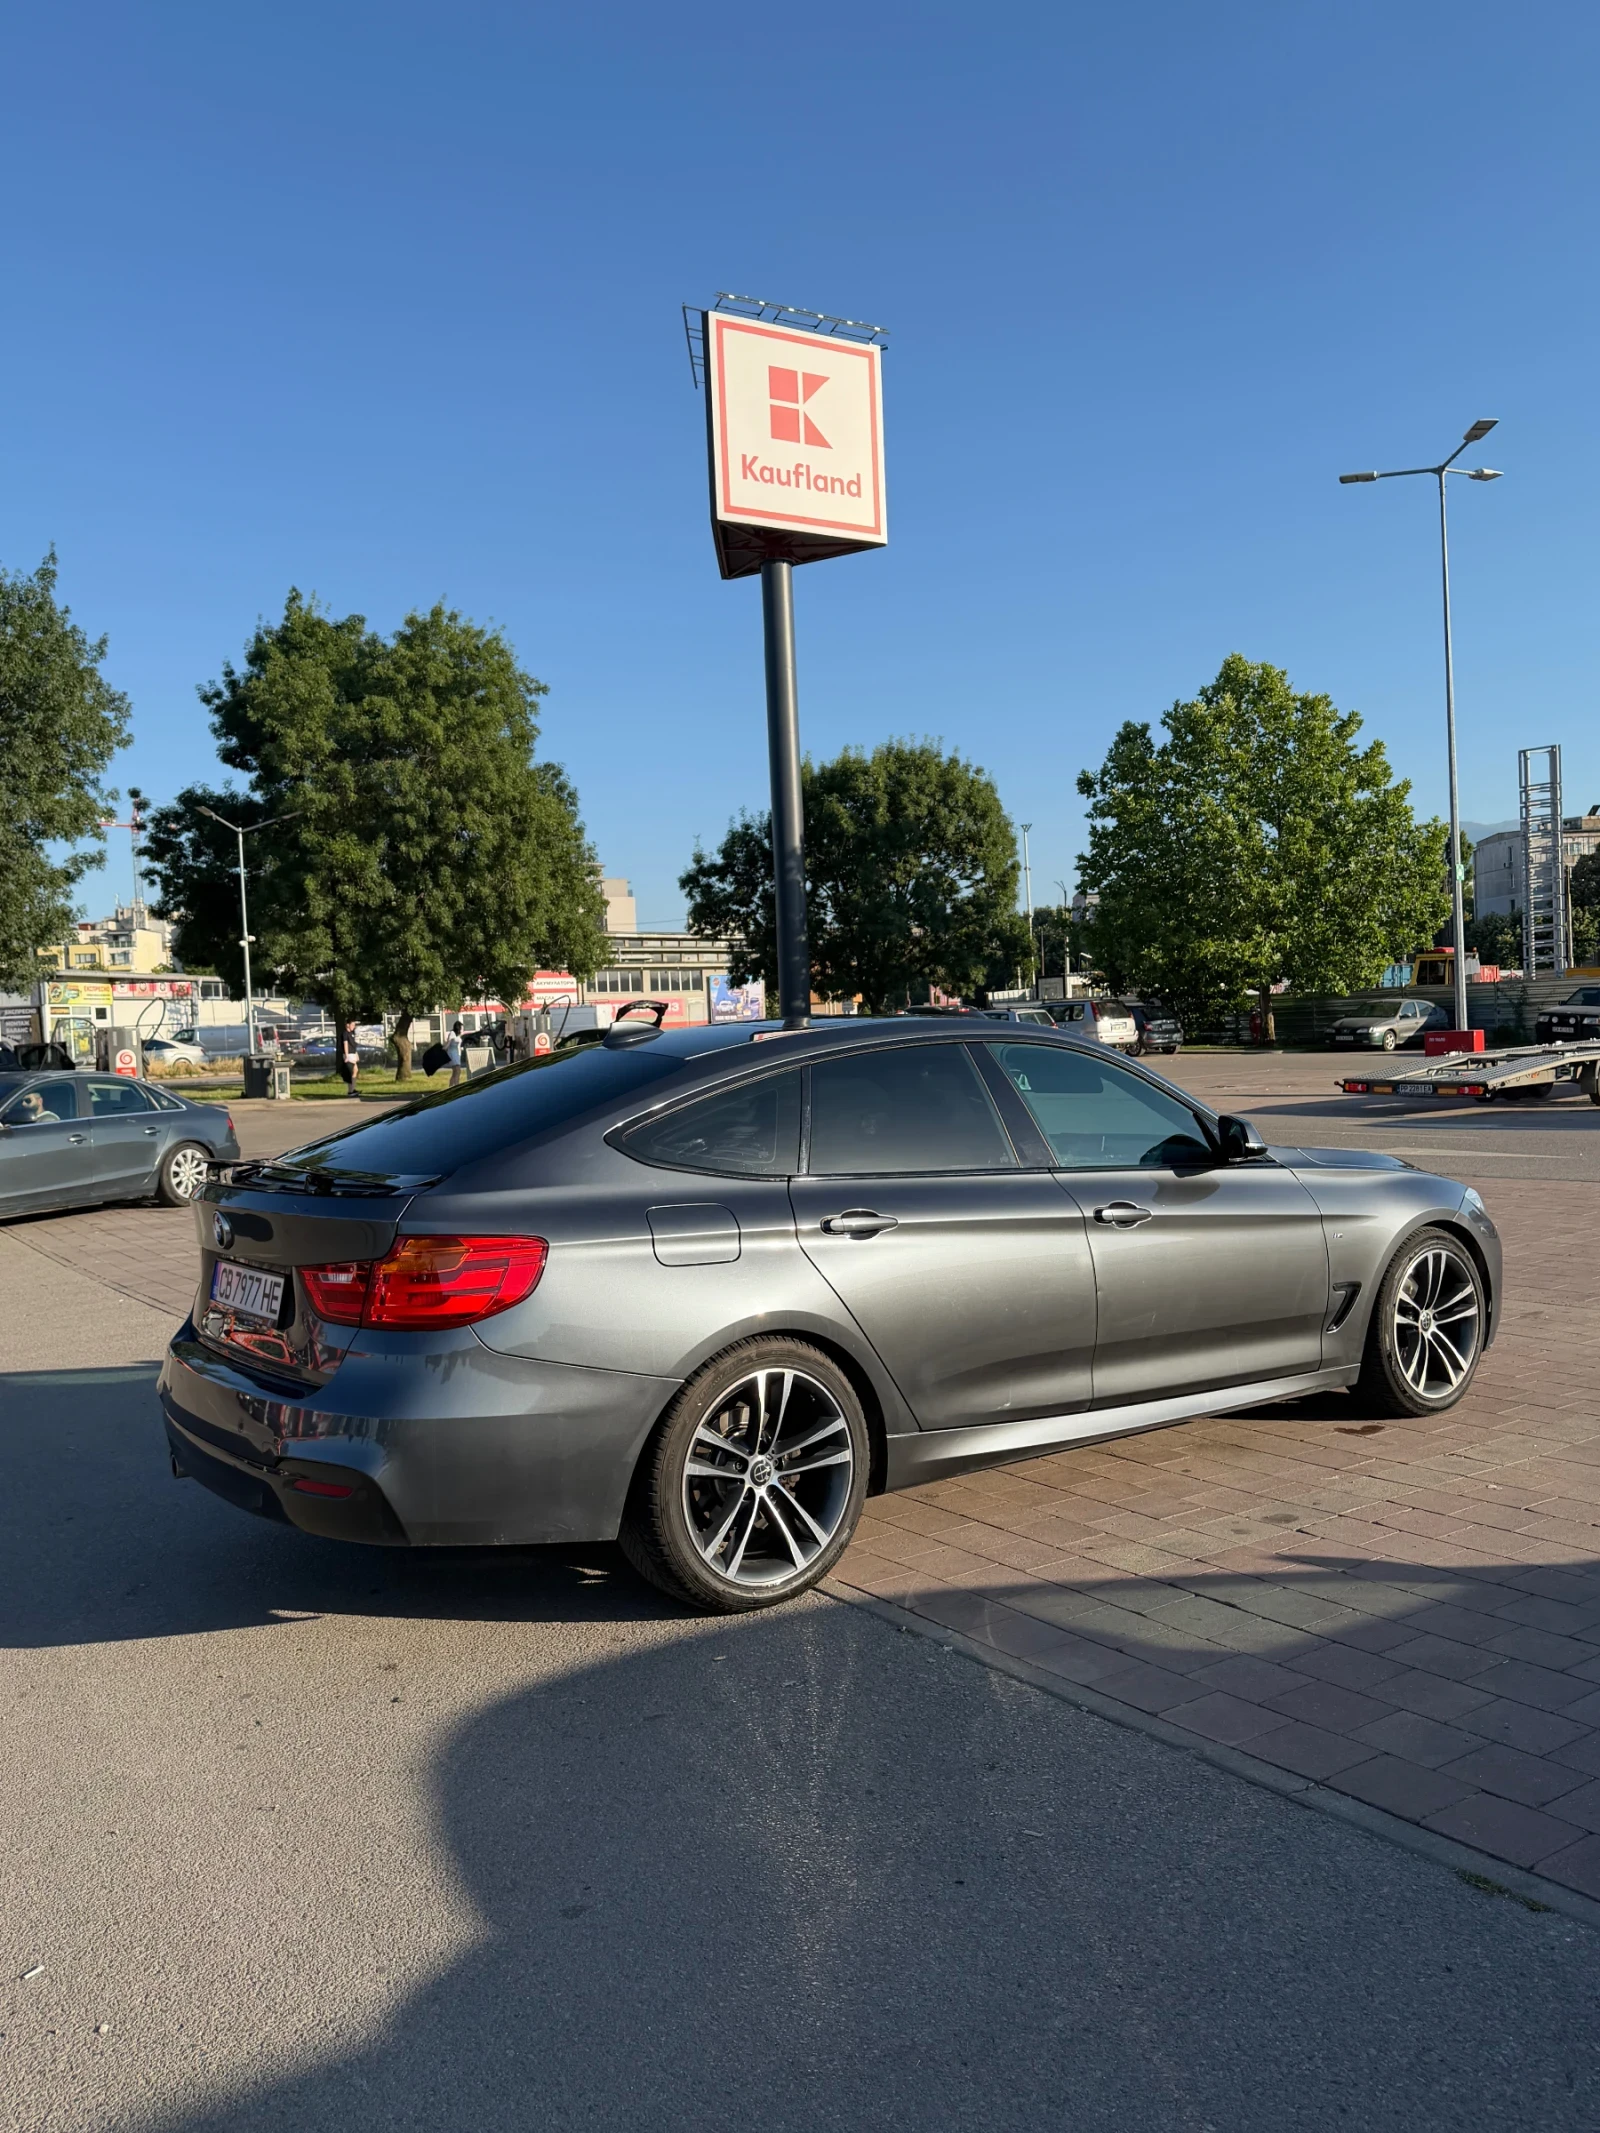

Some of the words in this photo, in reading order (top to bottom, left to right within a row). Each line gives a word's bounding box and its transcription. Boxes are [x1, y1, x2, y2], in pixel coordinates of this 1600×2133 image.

[741, 454, 862, 498] Kaufland
[218, 1267, 234, 1300] CB
[232, 1271, 262, 1308] 7977
[260, 1279, 282, 1314] HE
